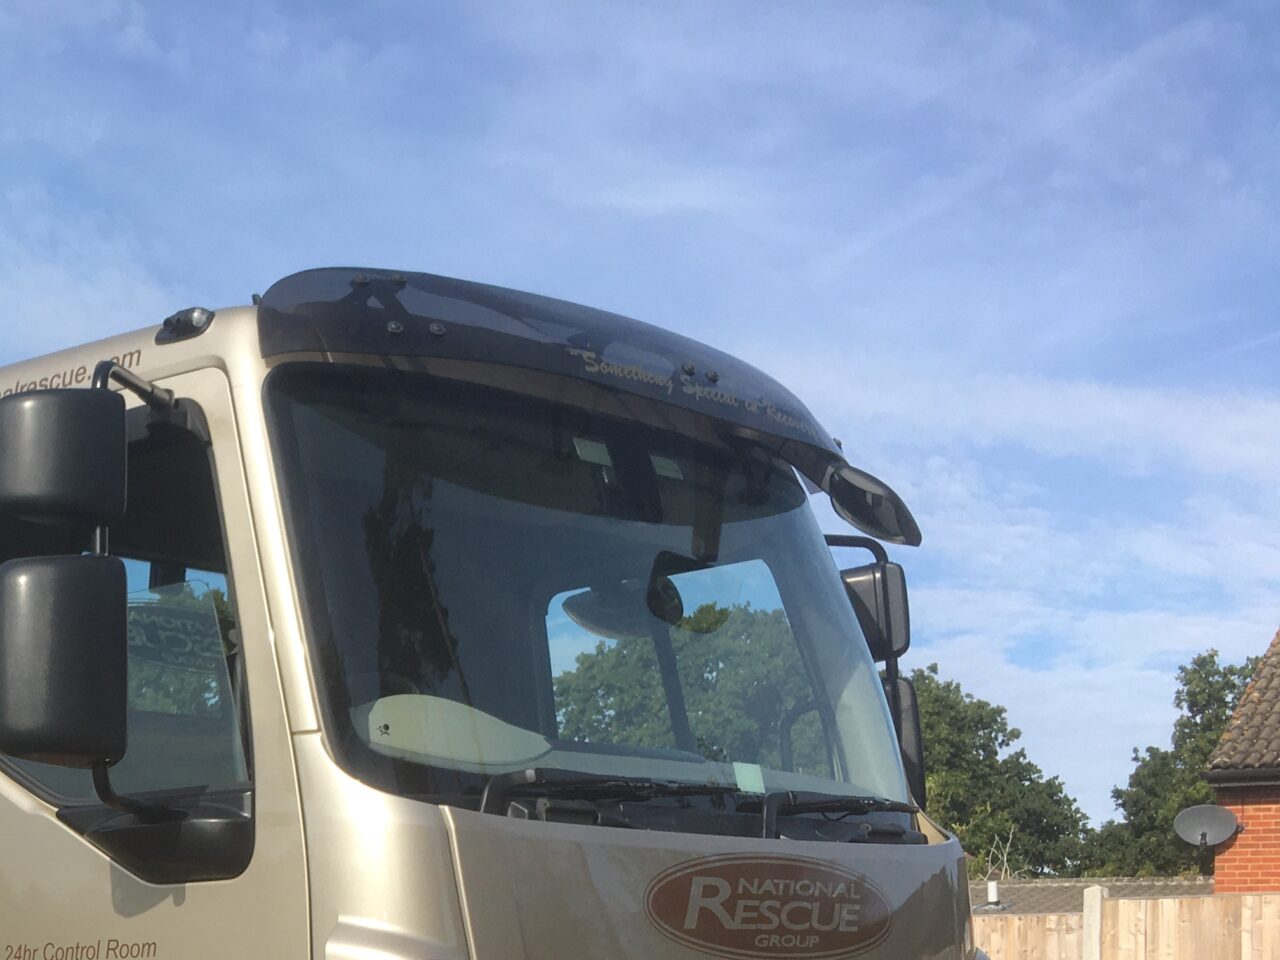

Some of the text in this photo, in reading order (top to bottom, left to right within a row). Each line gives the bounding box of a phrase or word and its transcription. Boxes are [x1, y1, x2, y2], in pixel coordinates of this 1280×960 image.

[736, 878, 861, 899] NATIONAL
[683, 876, 861, 933] RESCUE
[106, 938, 157, 960] Room
[754, 934, 820, 949] GROUP
